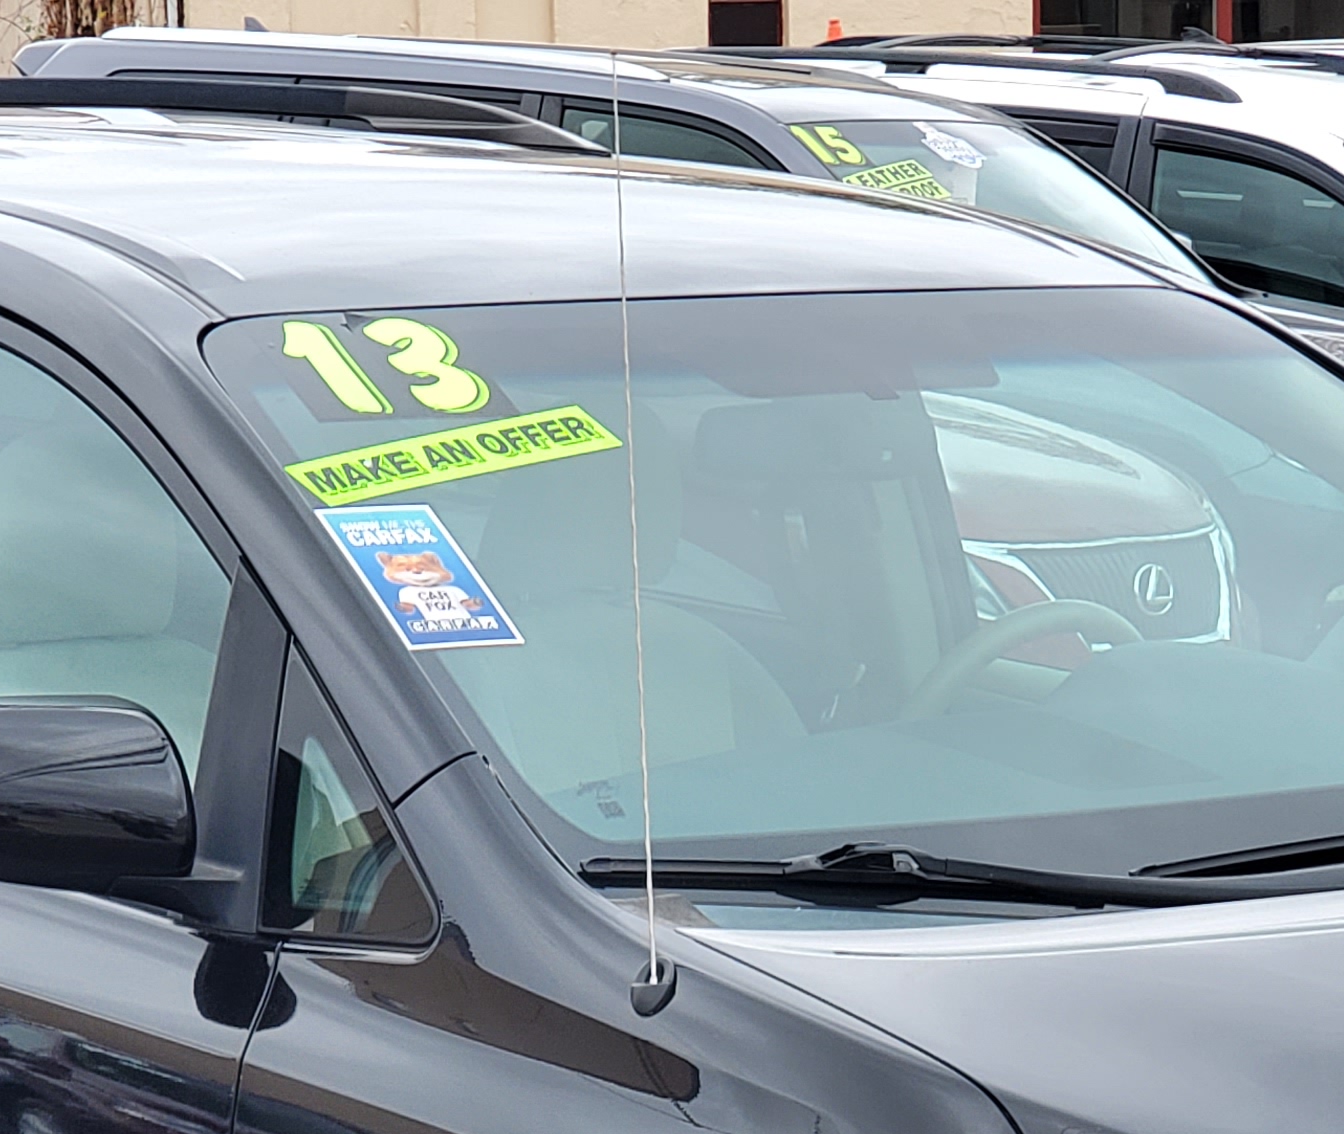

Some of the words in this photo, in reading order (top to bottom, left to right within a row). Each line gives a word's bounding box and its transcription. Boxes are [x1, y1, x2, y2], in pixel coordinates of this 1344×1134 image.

[789, 124, 867, 165] 15
[281, 316, 491, 415] 13
[304, 448, 424, 498] MAKE
[420, 437, 478, 473] AN
[475, 415, 597, 459] OFFER
[347, 527, 439, 547] CARFAX
